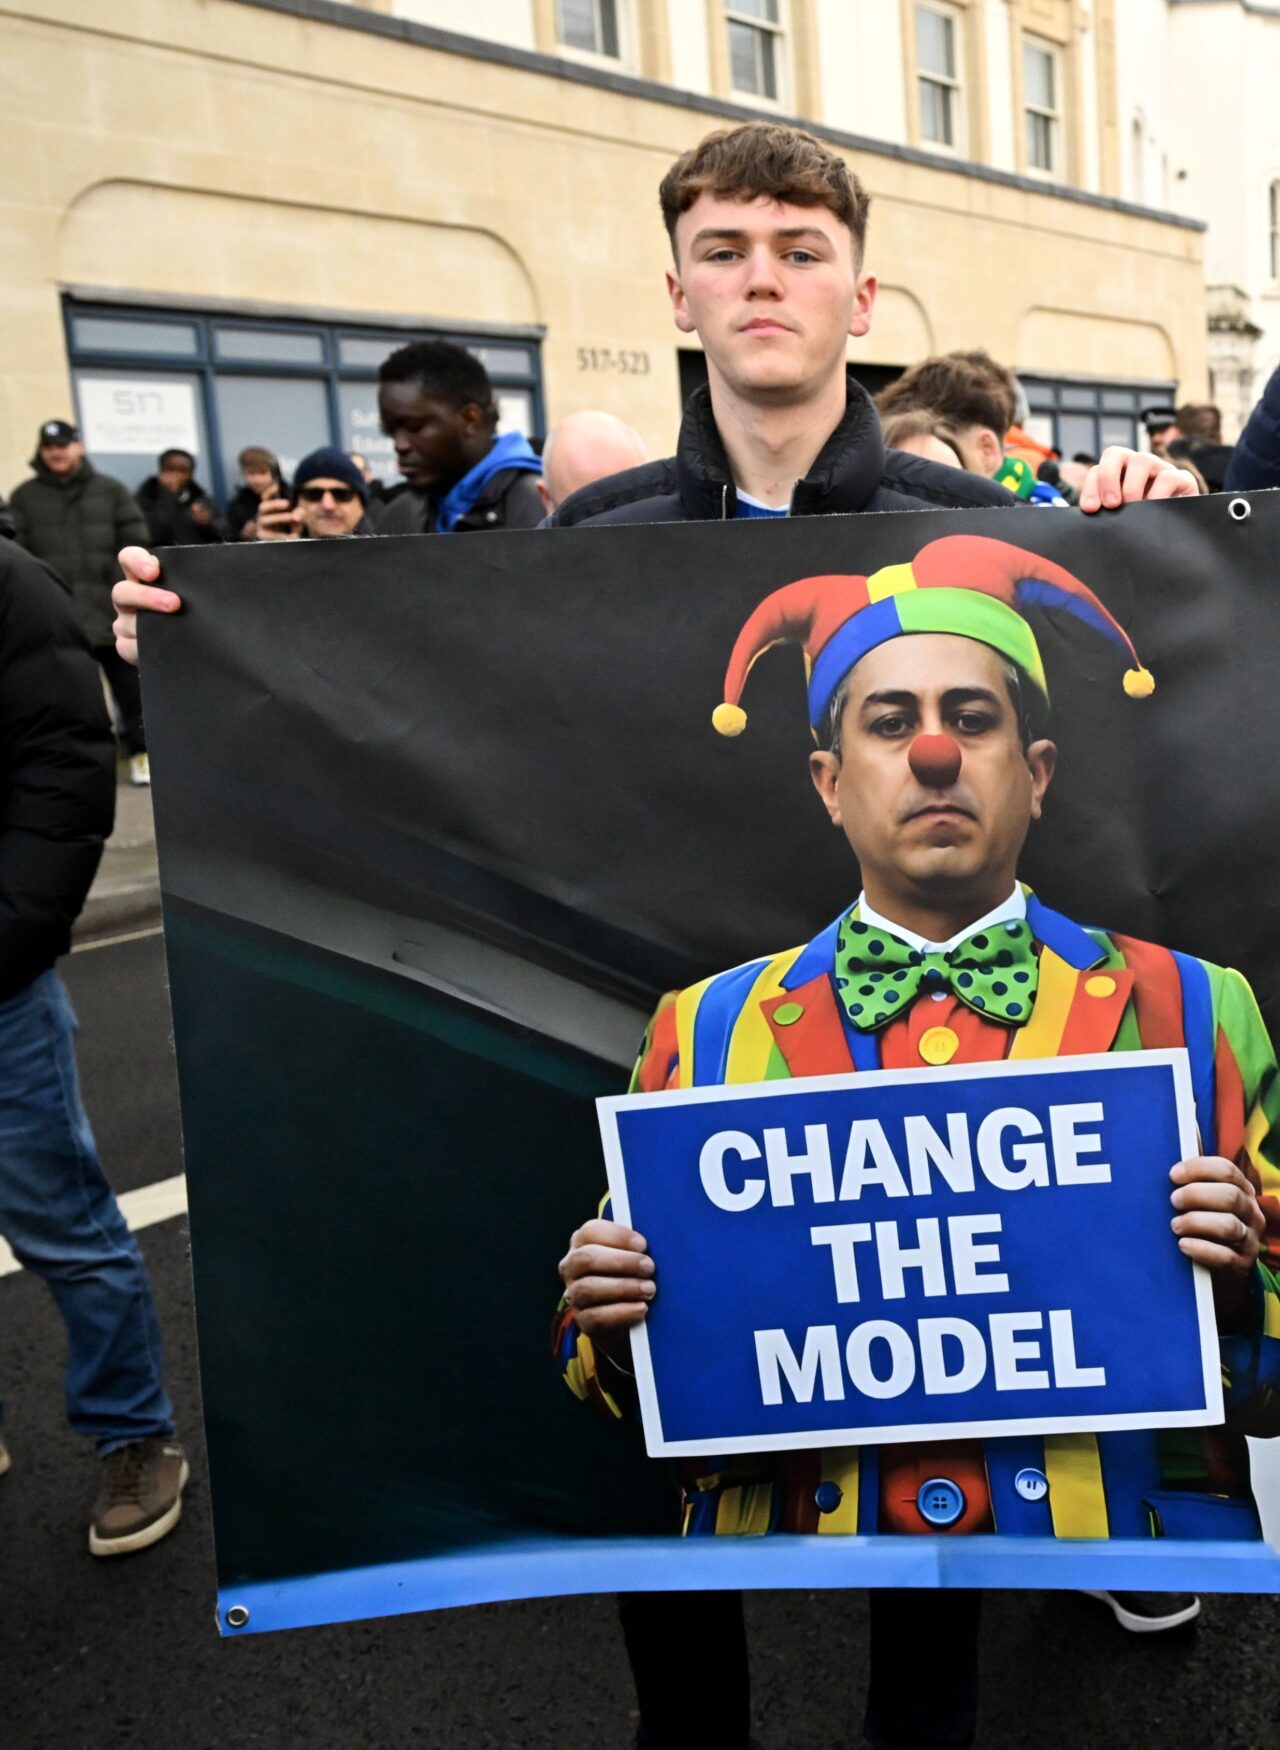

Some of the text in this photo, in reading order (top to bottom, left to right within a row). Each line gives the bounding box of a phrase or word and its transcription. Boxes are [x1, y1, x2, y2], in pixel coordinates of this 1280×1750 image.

[577, 348, 651, 374] 517-523
[699, 1101, 1112, 1212] CHANGE
[810, 1213, 1010, 1304] THE
[753, 1309, 1107, 1406] MODEL
